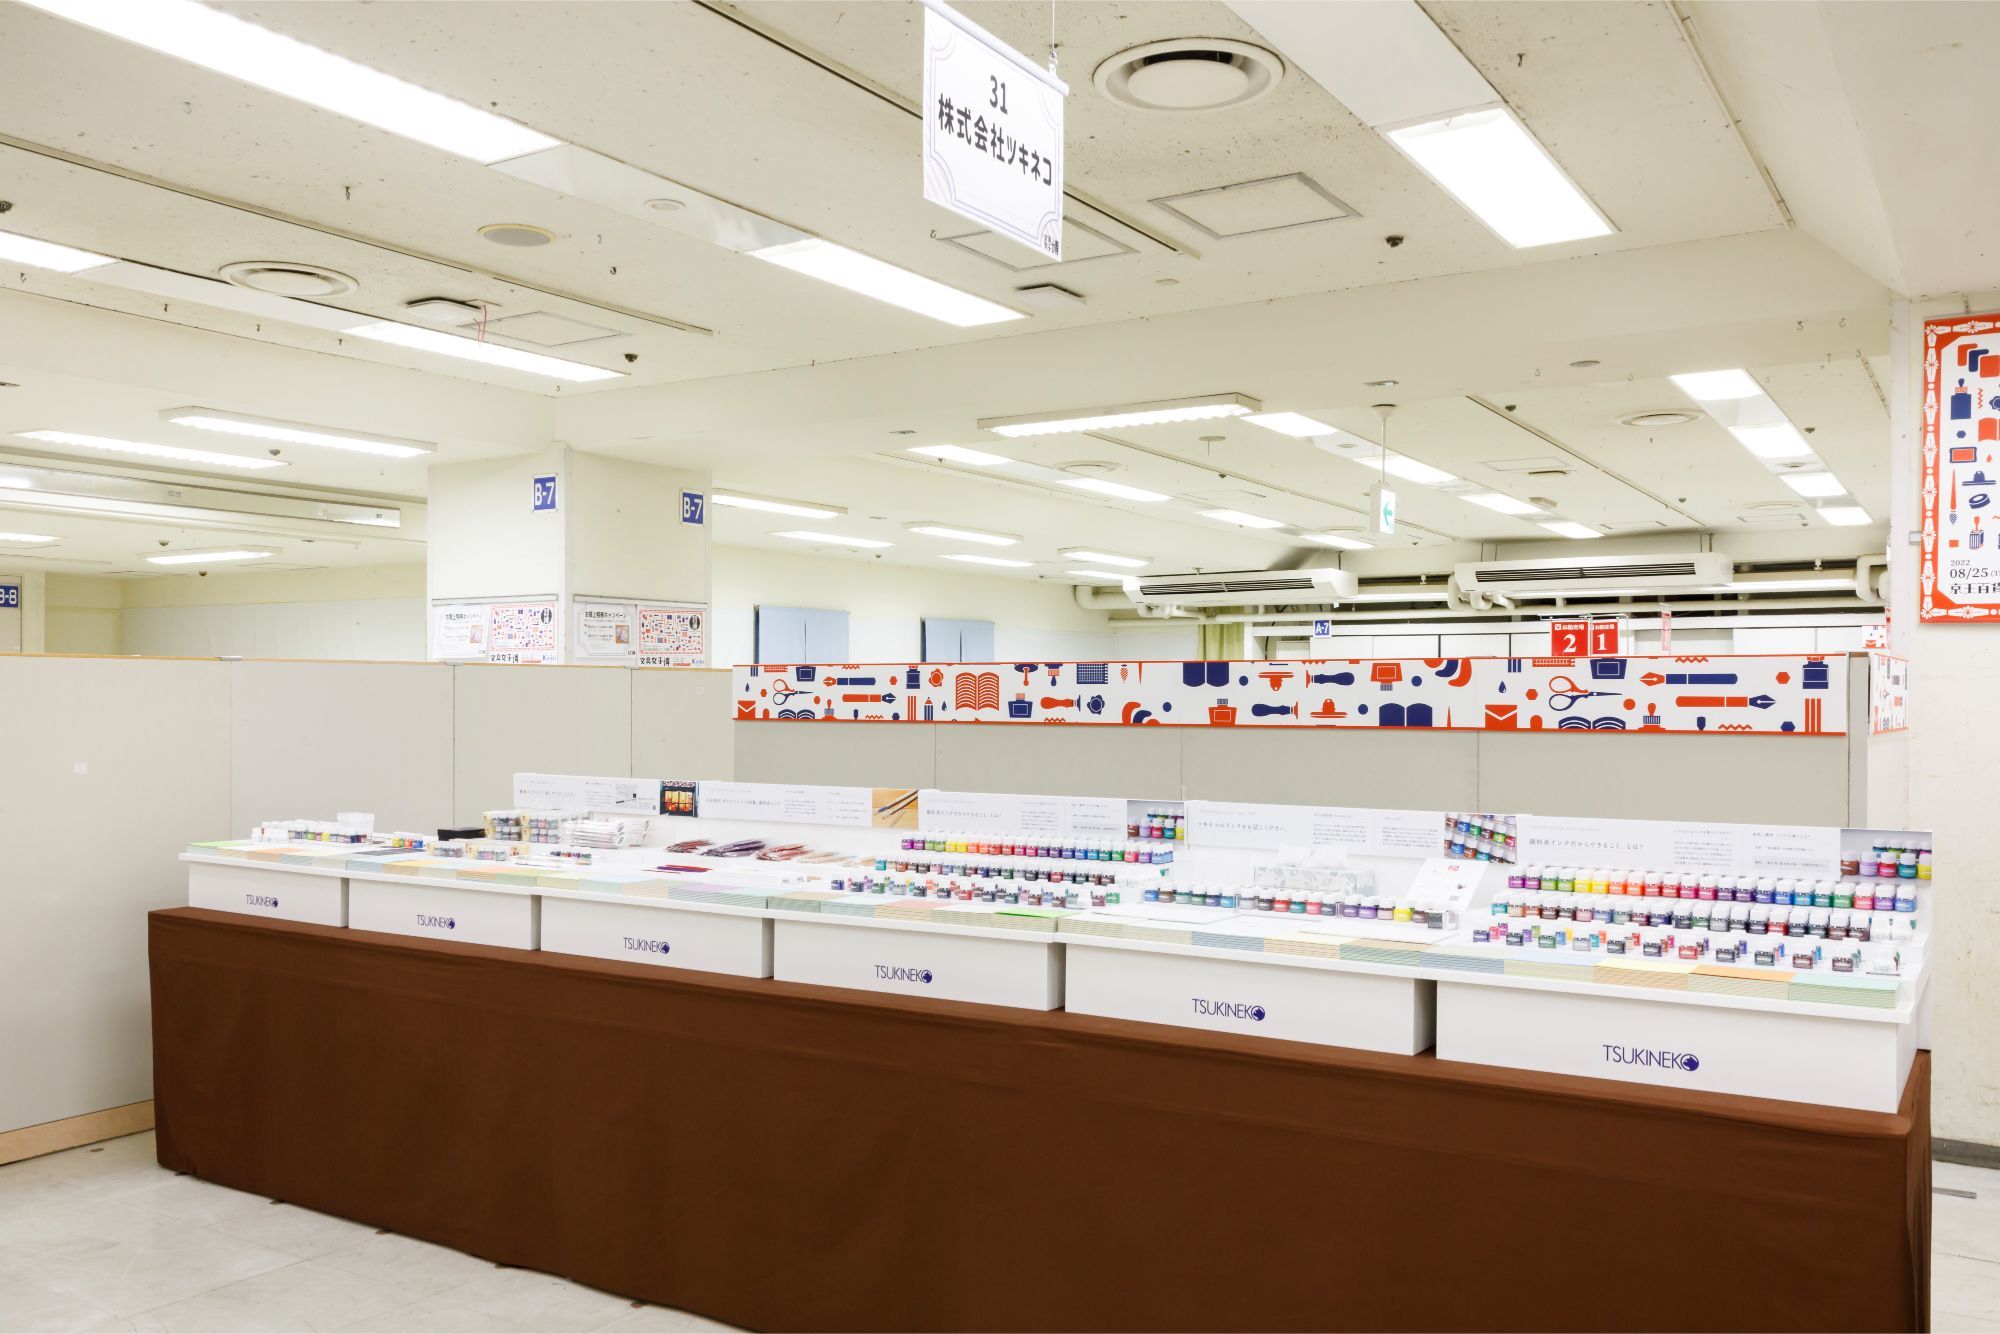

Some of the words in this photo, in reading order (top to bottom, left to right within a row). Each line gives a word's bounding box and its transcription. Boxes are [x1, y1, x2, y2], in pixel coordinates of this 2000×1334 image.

[989, 74, 1008, 115] 31
[937, 92, 1052, 187] 株式会社ツキネコ
[534, 482, 555, 506] B-7
[683, 496, 703, 520] B-7
[1949, 568, 1989, 580] 08/25
[1315, 622, 1329, 634] A-7
[1563, 633, 1577, 653] 2
[1596, 633, 1608, 651] 1
[416, 914, 456, 930] TSUKINEKO
[623, 937, 670, 955] TSUKINEKO
[874, 964, 933, 984] TSUKINEKO
[1191, 998, 1266, 1021] TSUKINEKO
[1602, 1044, 1700, 1072] TSUKINEKO
